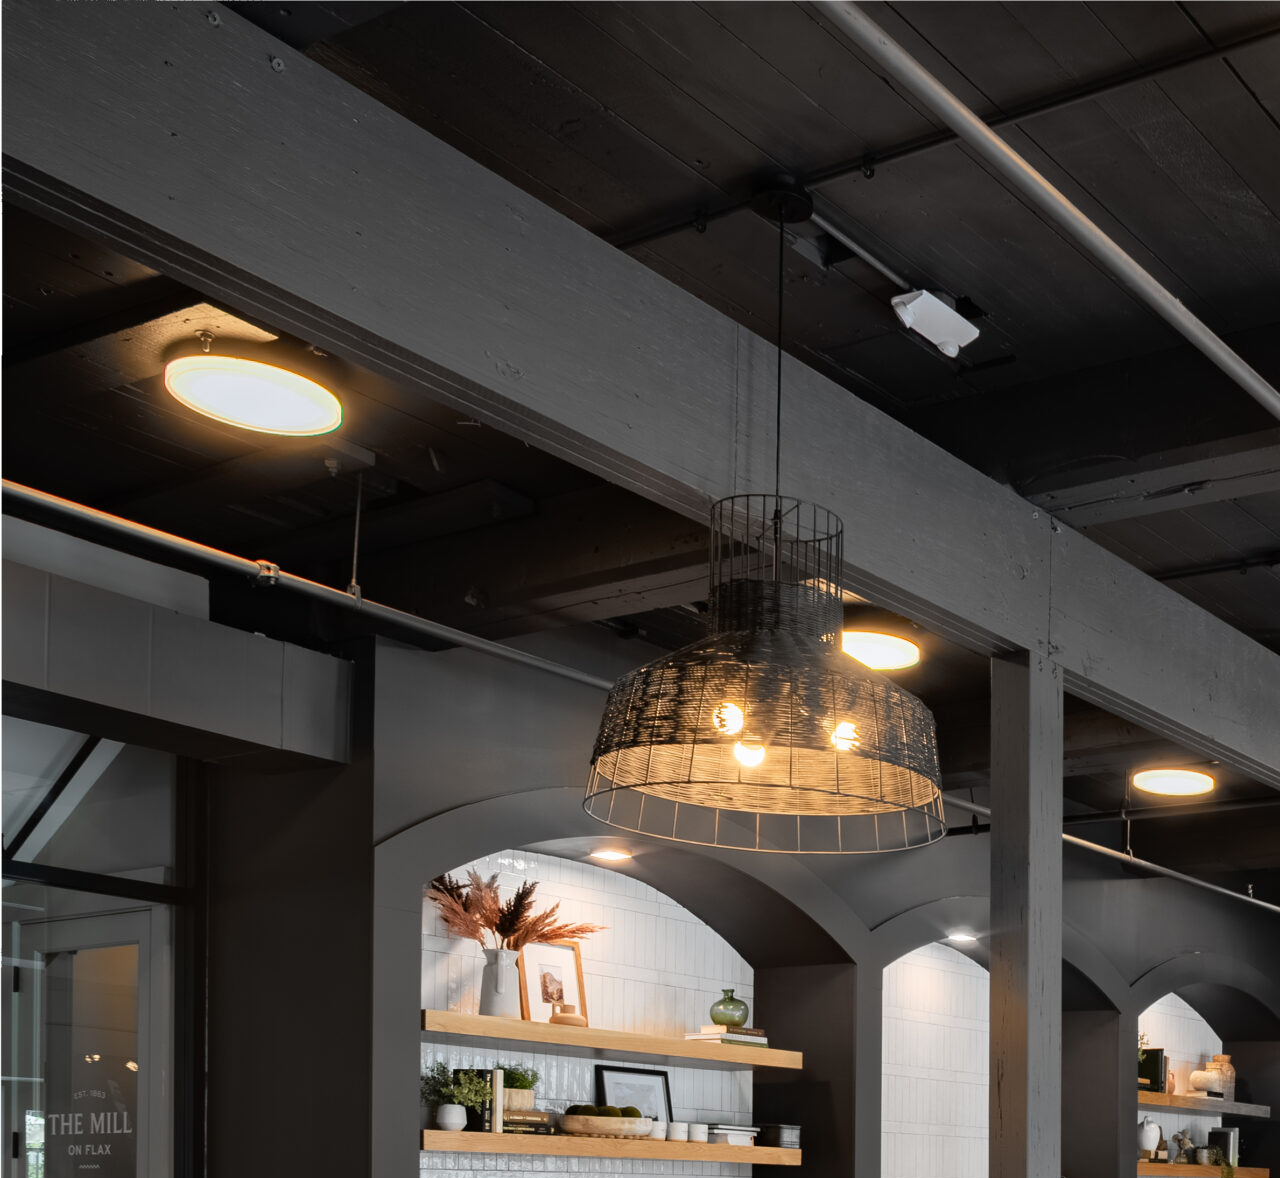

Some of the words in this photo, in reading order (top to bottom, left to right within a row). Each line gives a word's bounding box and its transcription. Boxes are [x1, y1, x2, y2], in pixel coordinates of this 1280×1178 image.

[48, 1113, 84, 1136] THE
[90, 1111, 133, 1134] MILL
[68, 1144, 82, 1156] ON
[85, 1144, 112, 1156] FLAX
